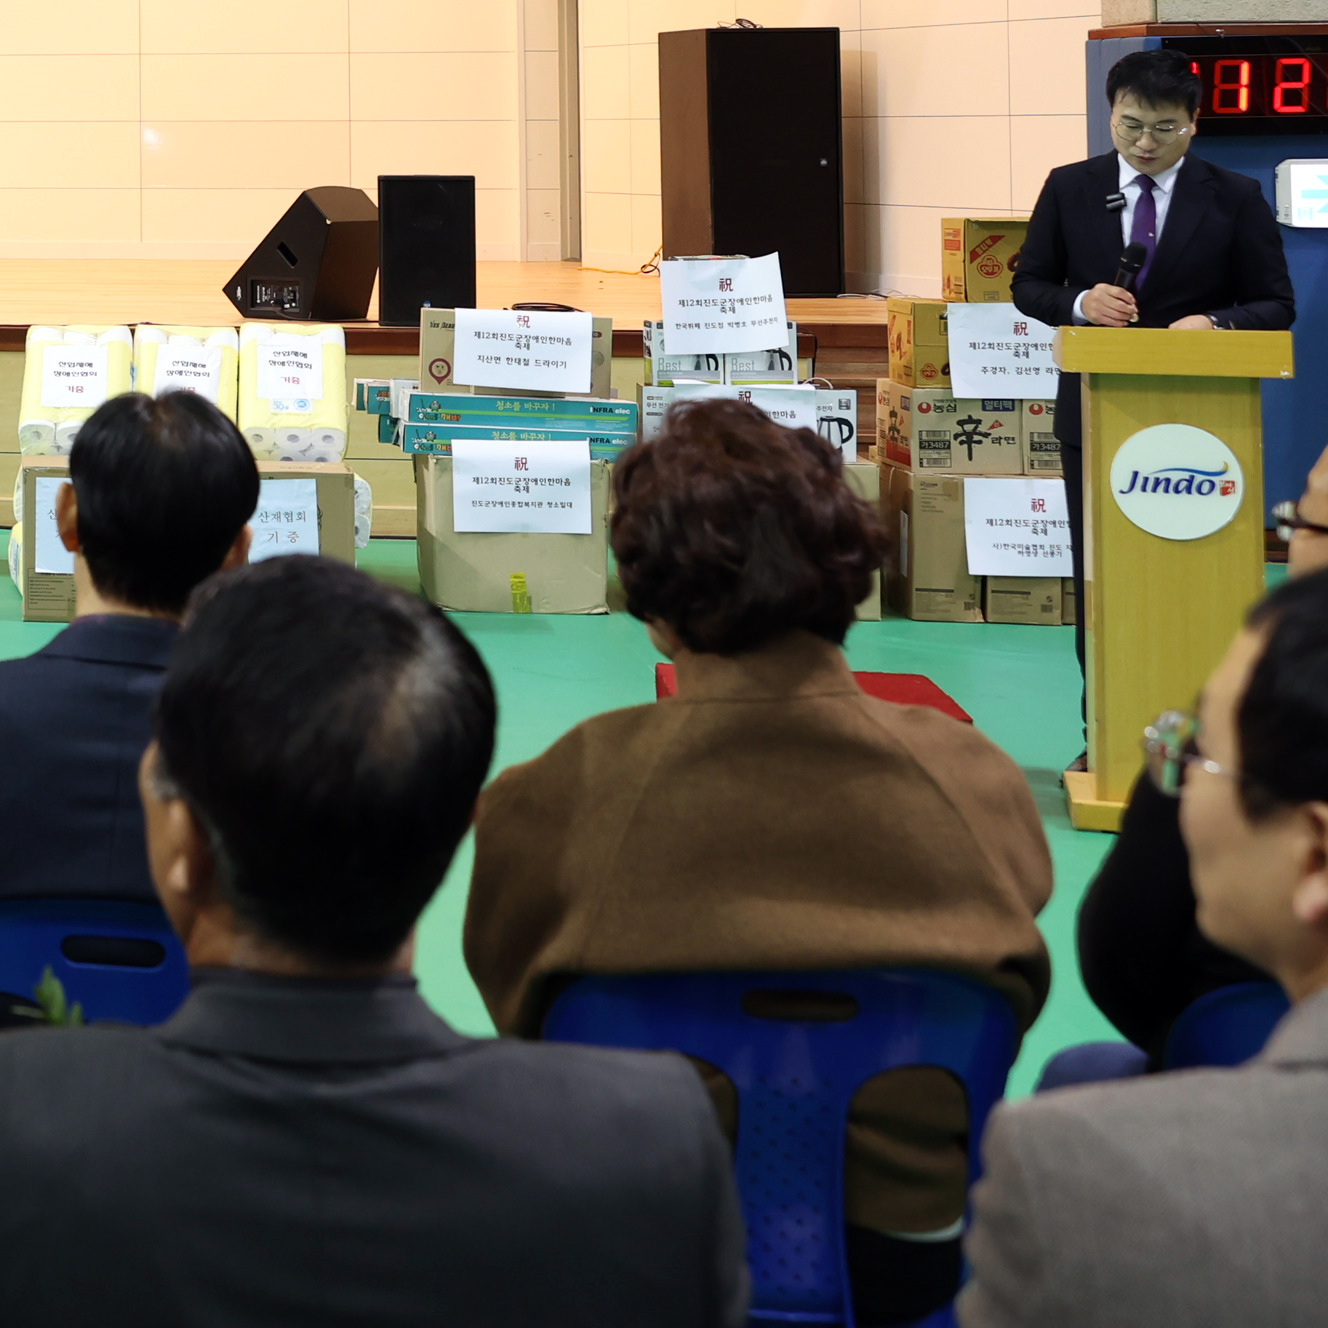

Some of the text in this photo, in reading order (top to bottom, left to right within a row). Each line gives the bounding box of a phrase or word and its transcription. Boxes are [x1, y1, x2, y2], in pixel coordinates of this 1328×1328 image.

[718, 278, 734, 292] 祝
[678, 294, 773, 308] 제12회진도군장애인한마음
[719, 306, 736, 314] 축제
[516, 315, 530, 329] 祝
[1013, 321, 1029, 336] 祝
[474, 331, 572, 346] 제12회진도군장애인한마음
[514, 342, 531, 351] 축제
[1013, 350, 1030, 359] 축제
[534, 358, 567, 369] 드라이기
[658, 358, 683, 371] Best
[731, 358, 756, 371] Best
[496, 400, 521, 412] 청소를
[933, 400, 1014, 413] 농심 멀티팩
[953, 414, 992, 462] 辛
[991, 436, 1016, 445] 라면
[514, 457, 529, 471] 祝
[472, 476, 572, 487] 제12회진도군장애인한마음
[1118, 468, 1216, 497] Jindo
[513, 485, 530, 494] 축제
[1030, 498, 1046, 513] 祝
[258, 510, 306, 523] 산재협회
[1031, 528, 1048, 536] 축제
